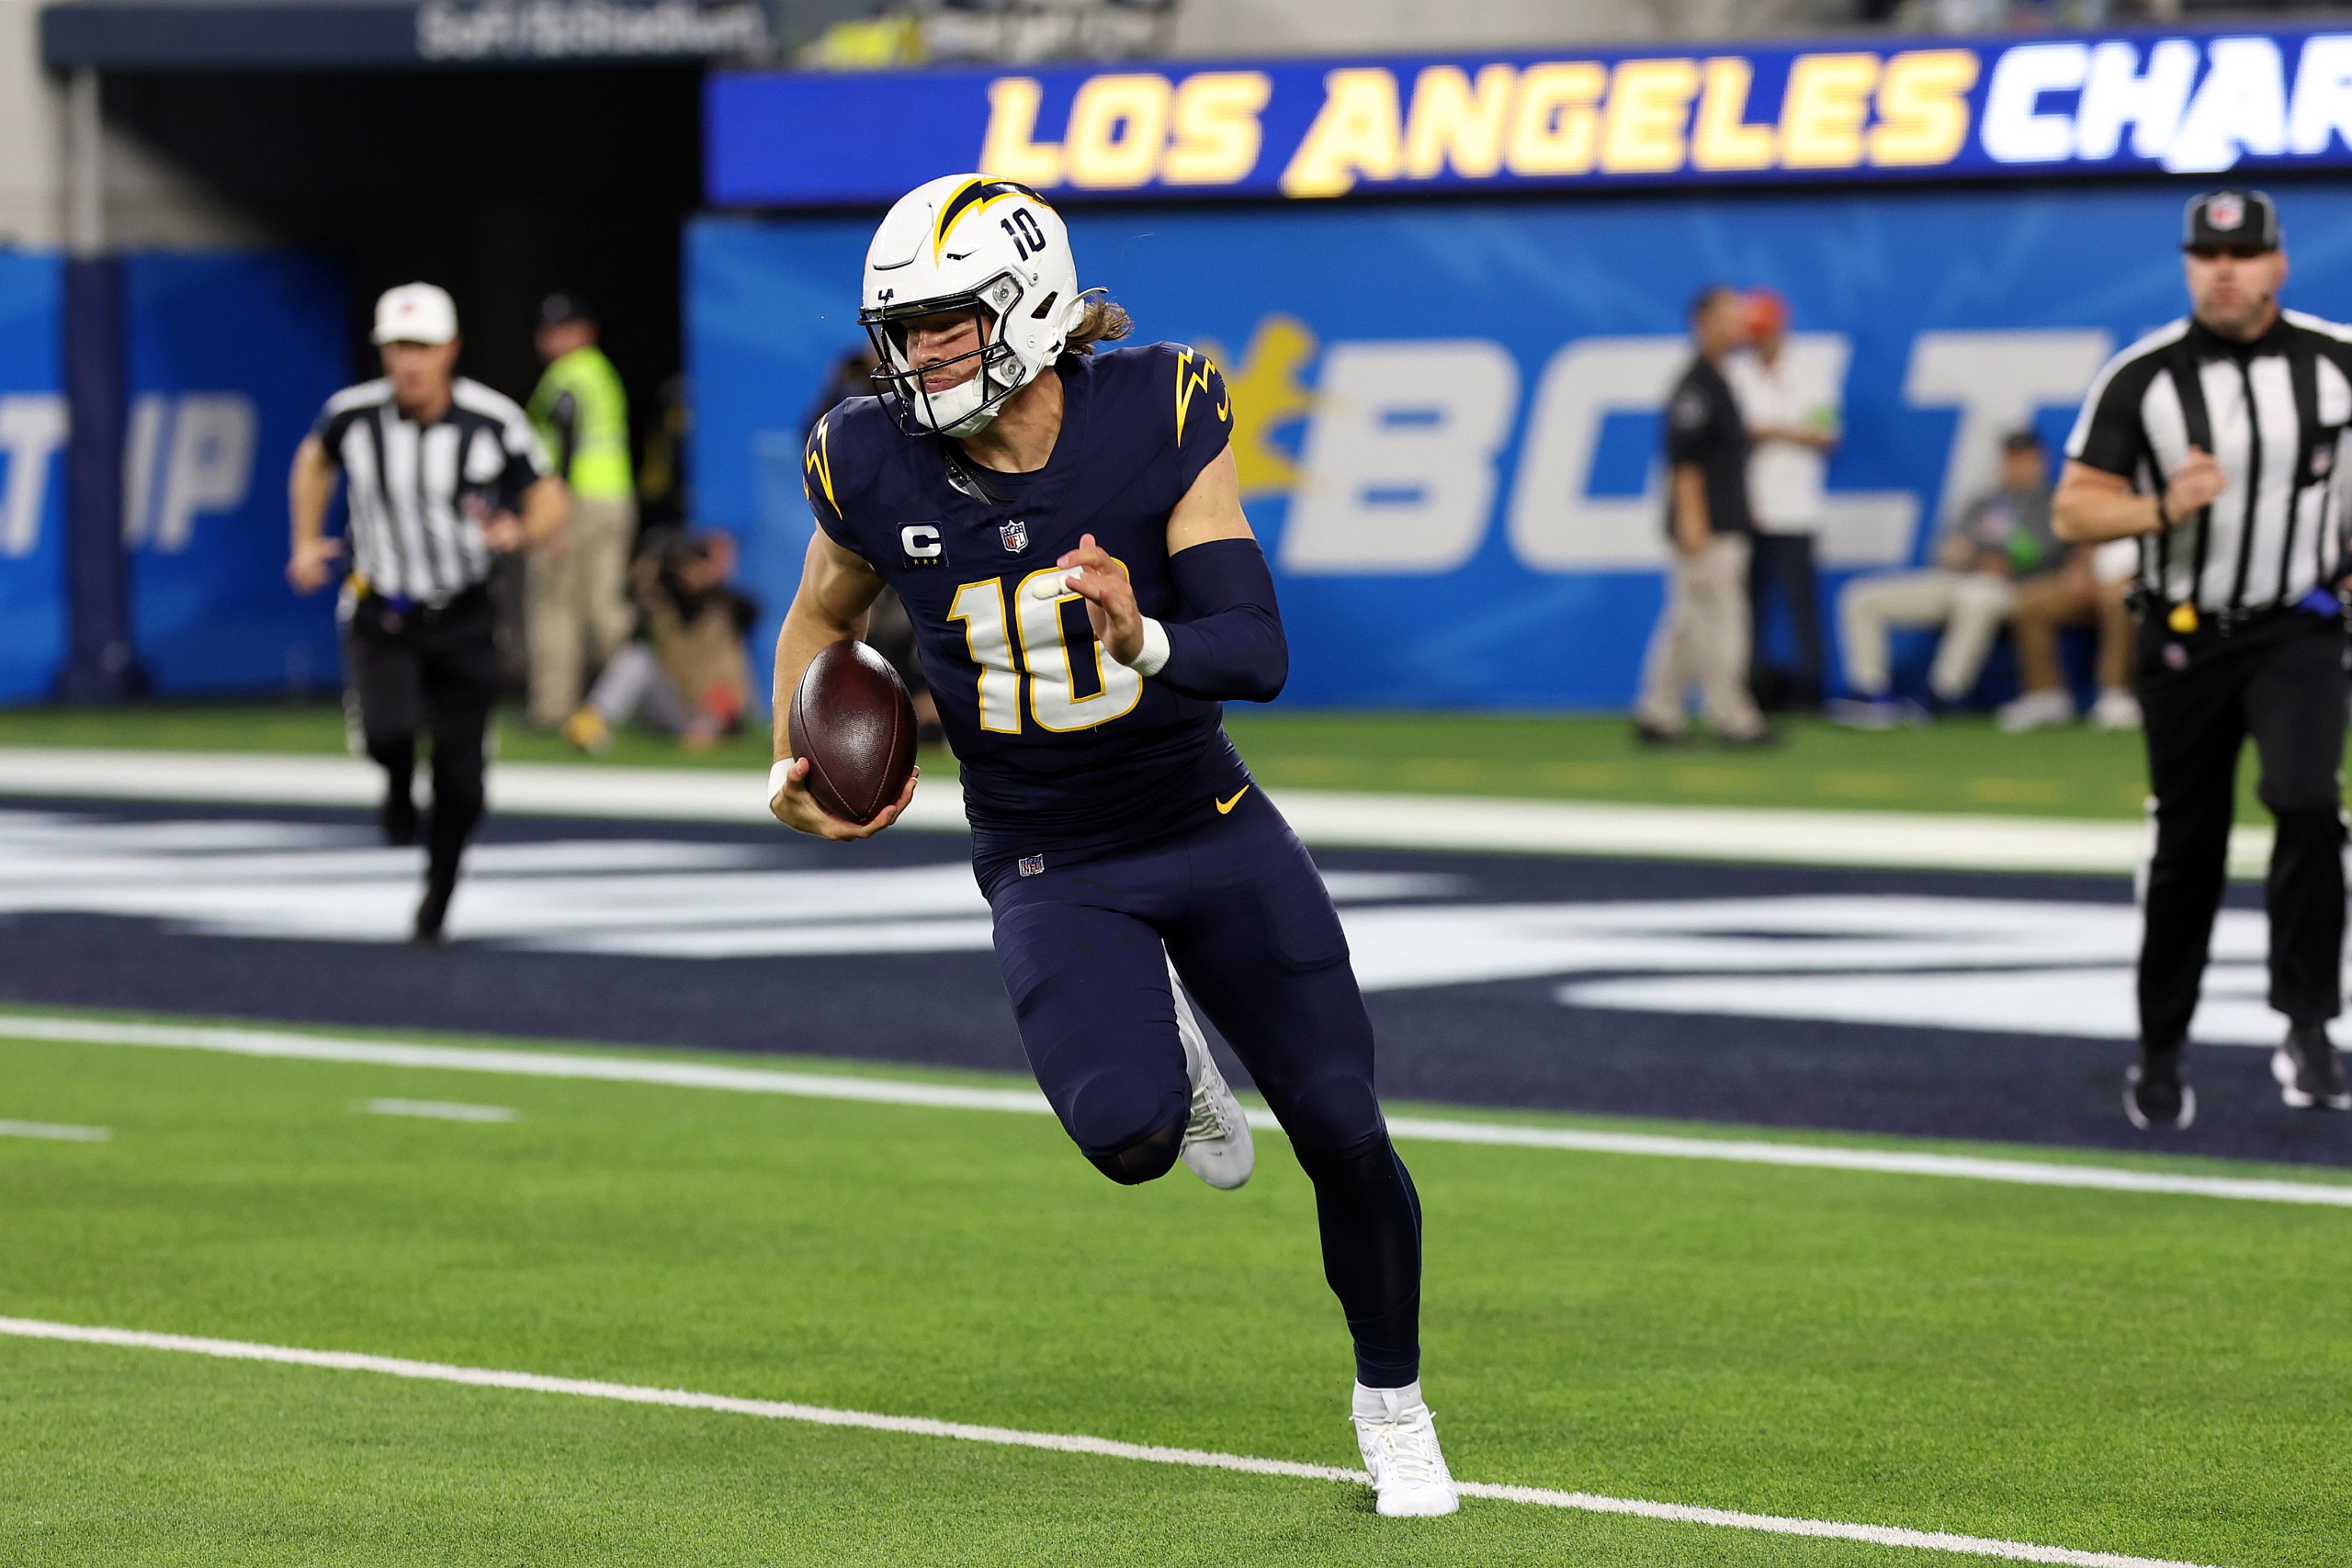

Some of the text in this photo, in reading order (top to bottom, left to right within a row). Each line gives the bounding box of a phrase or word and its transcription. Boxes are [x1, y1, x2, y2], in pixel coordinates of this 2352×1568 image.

[983, 37, 2352, 195] LOS ANGELES CHAR
[1001, 208, 1046, 262] 10
[901, 525, 941, 558] C
[946, 558, 1143, 734] 10
